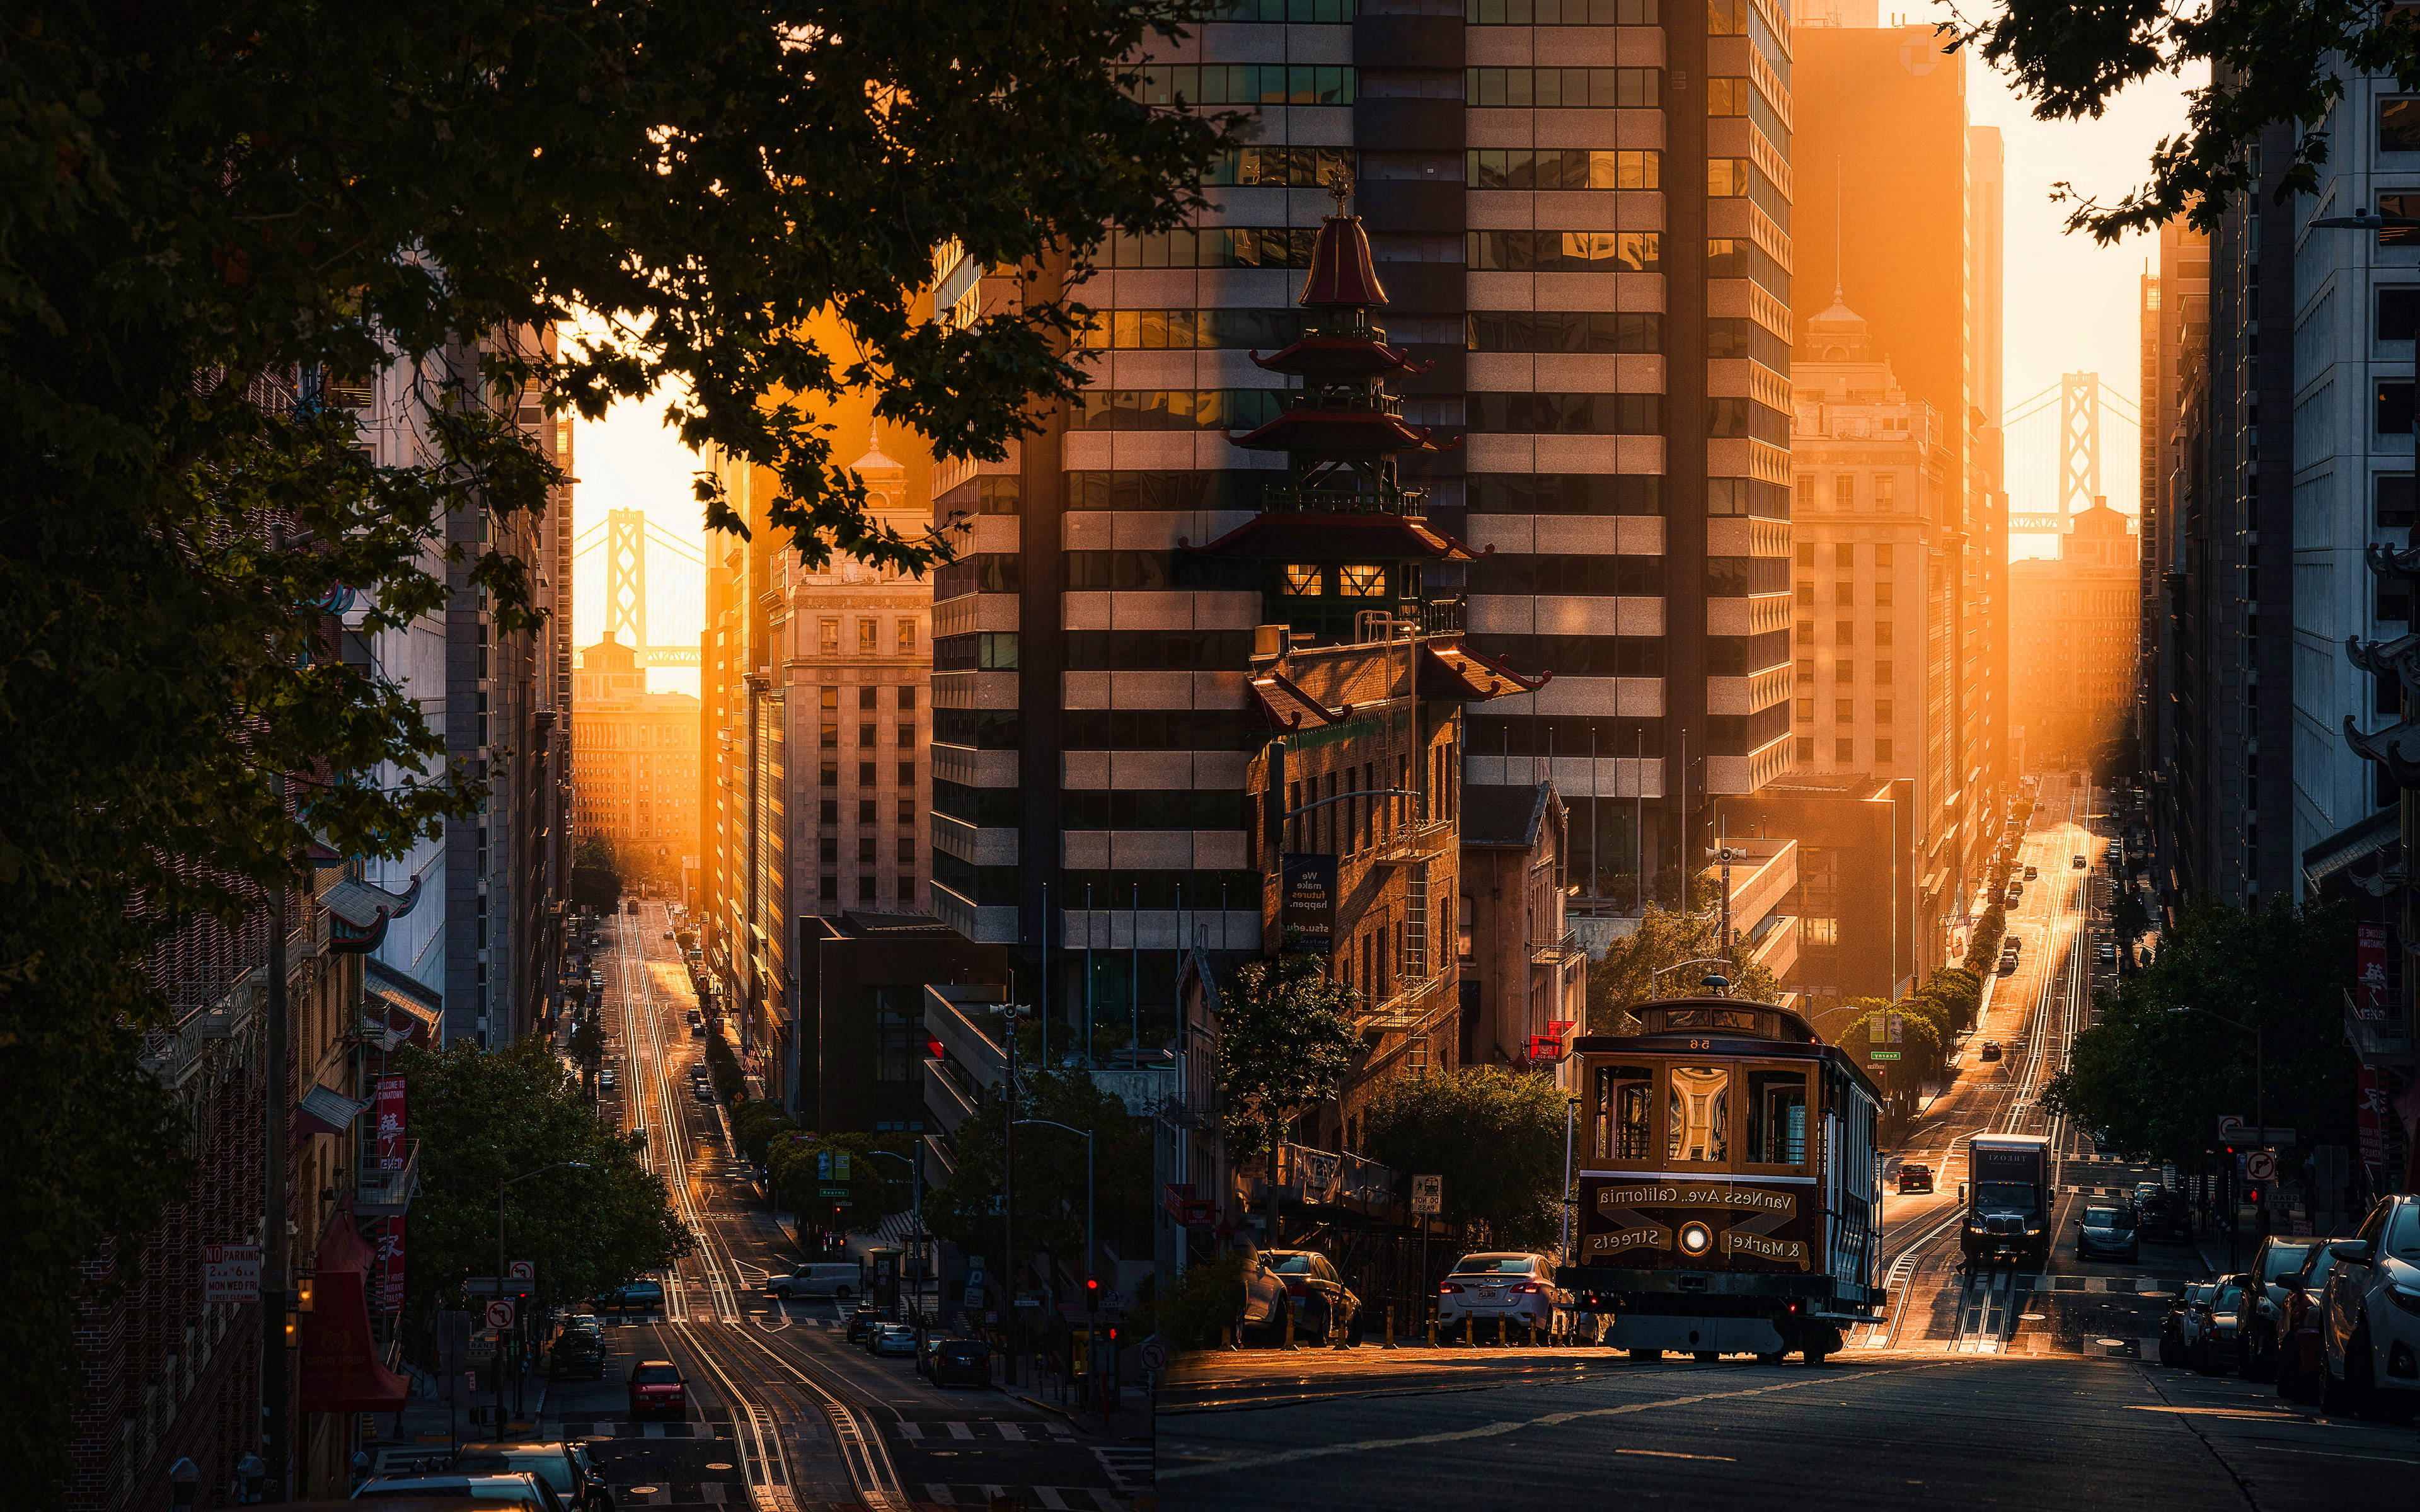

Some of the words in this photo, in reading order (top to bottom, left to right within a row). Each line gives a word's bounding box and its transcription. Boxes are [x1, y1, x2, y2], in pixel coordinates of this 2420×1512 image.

[206, 1247, 221, 1261] NO
[224, 1250, 259, 1261] PARKING
[209, 1266, 216, 1276] 2
[236, 1266, 242, 1276] 6
[209, 1281, 225, 1290] MON
[227, 1281, 243, 1290] WED
[245, 1280, 257, 1290] FRI
[304, 1355, 335, 1366] CATHAY
[338, 1355, 368, 1365] HOUSE
